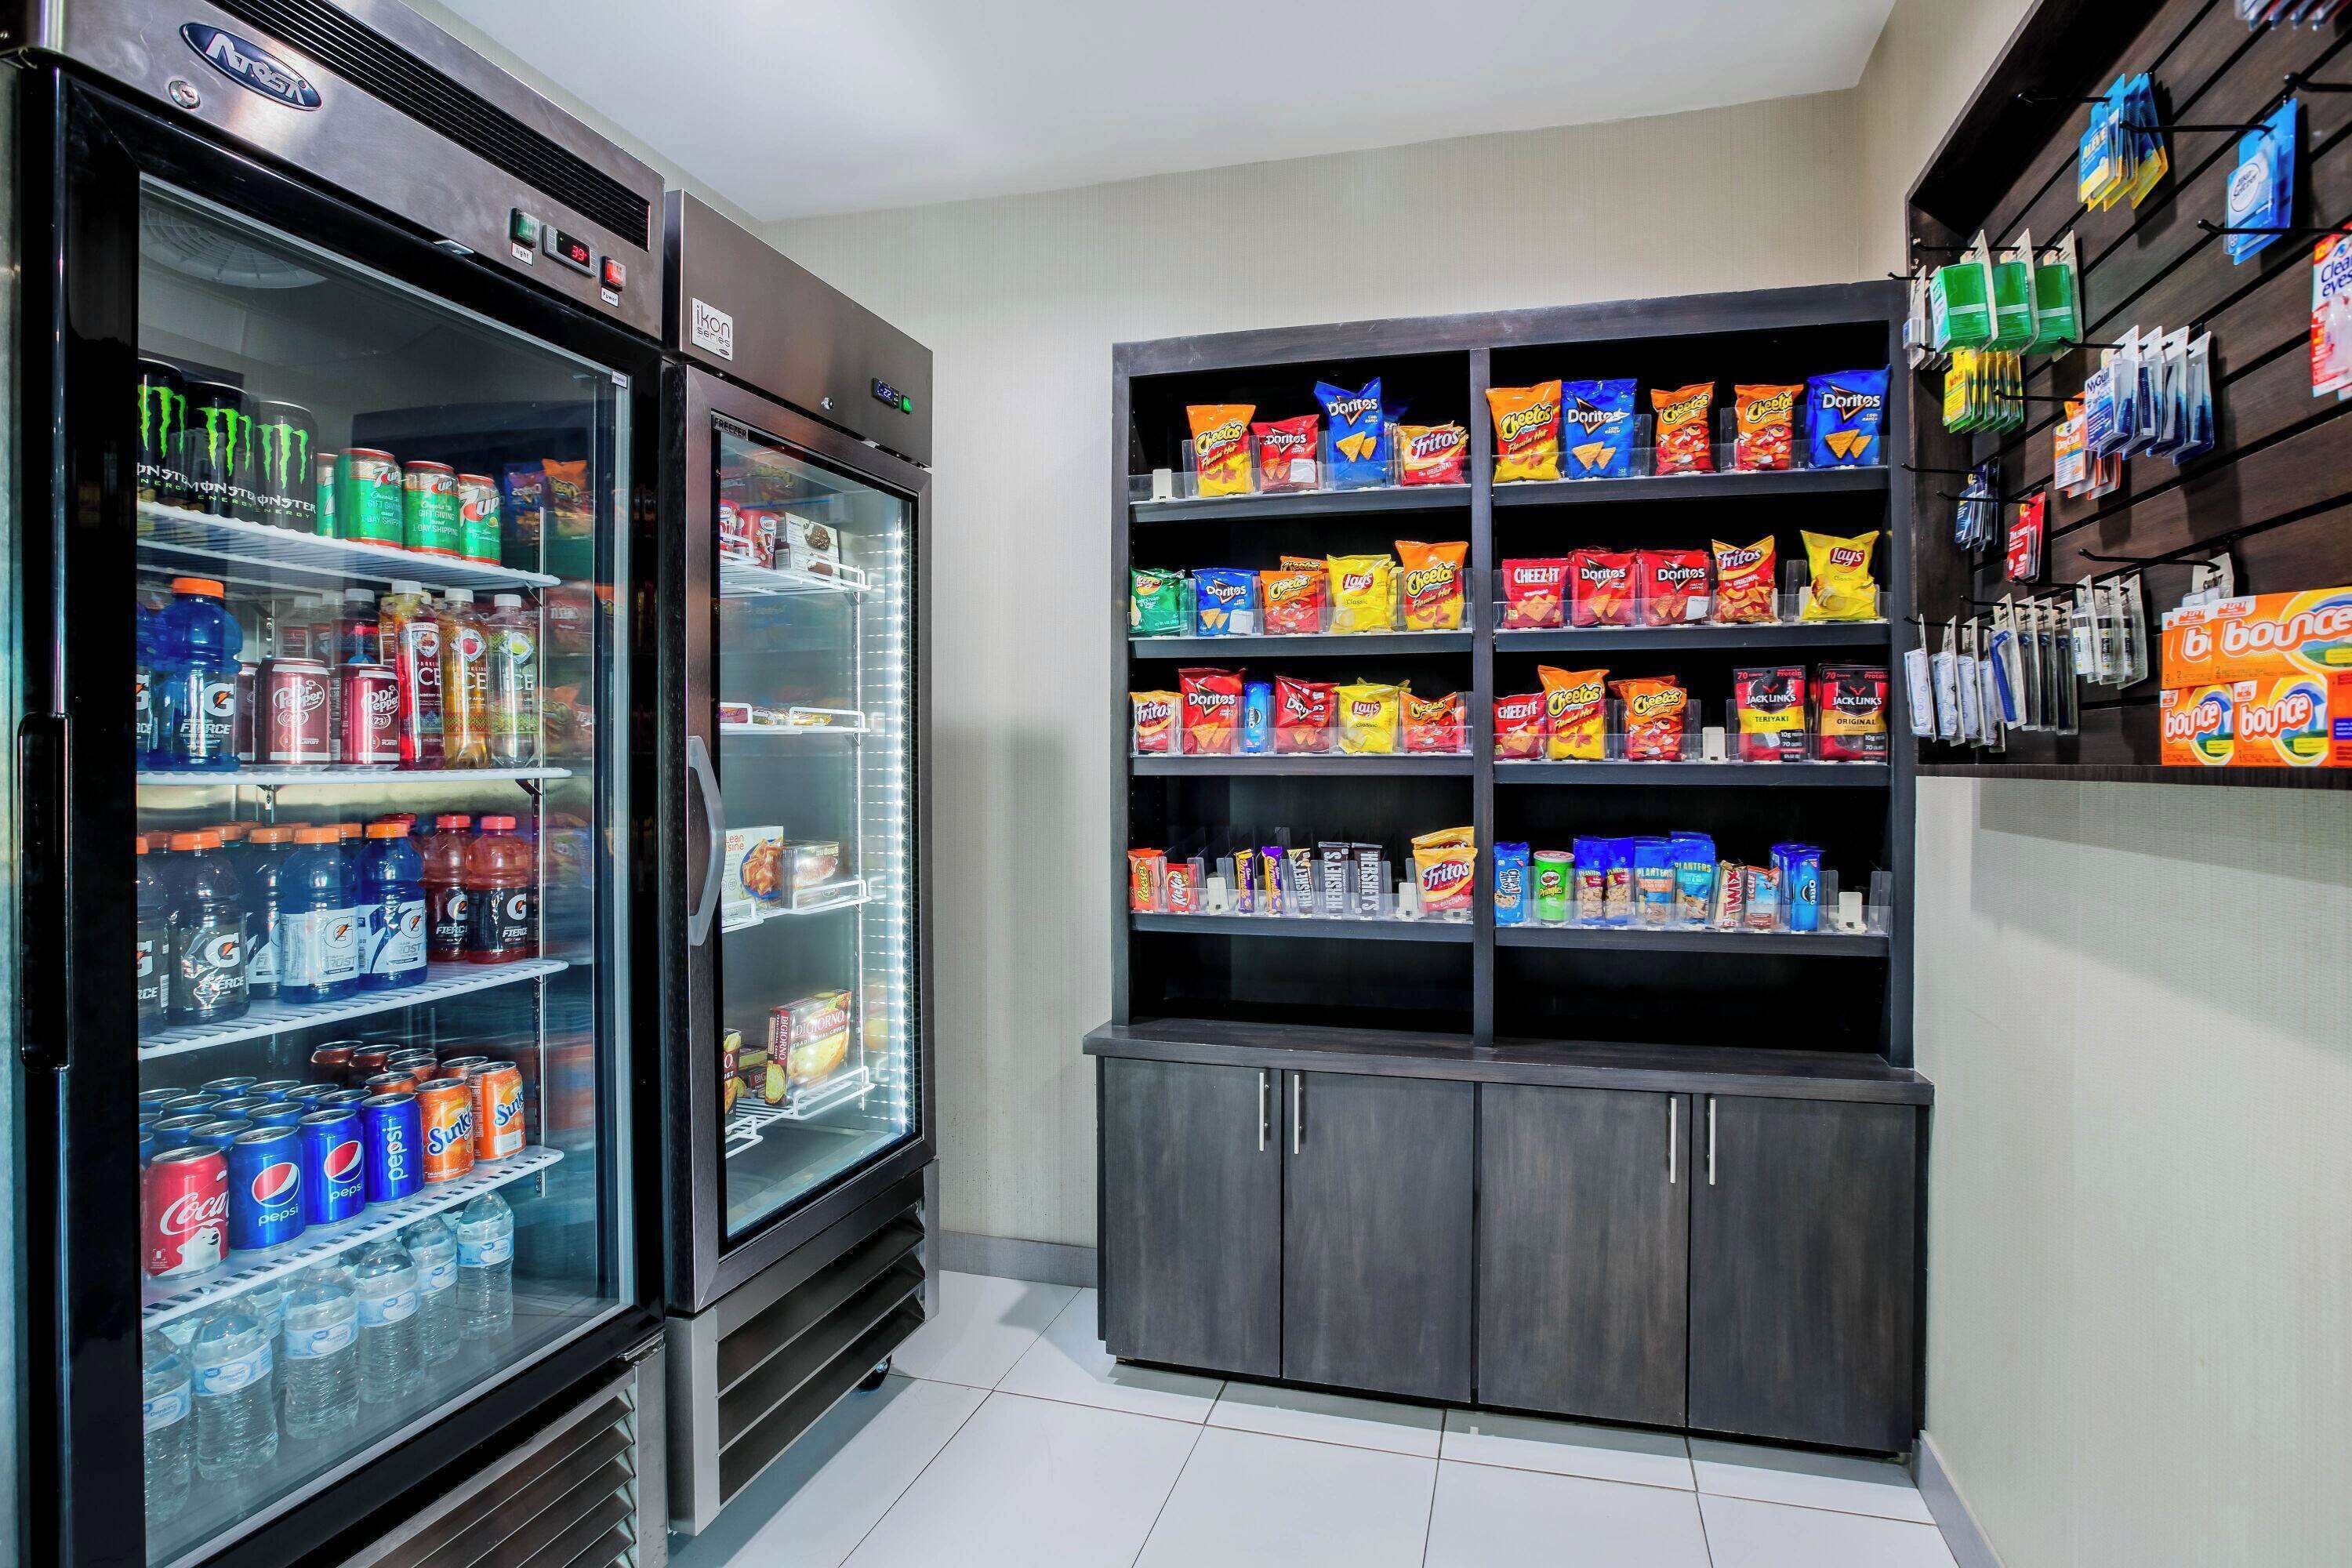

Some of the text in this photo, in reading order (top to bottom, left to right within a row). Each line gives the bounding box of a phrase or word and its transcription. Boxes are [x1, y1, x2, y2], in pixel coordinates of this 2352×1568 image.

[515, 246, 530, 260] light
[2321, 256, 2352, 283] Clea
[695, 303, 731, 338] ikon
[696, 326, 731, 347] series
[1327, 397, 1378, 416] Doritos
[1661, 392, 1710, 424] Cheetos
[1822, 393, 1881, 409] Doritos
[1500, 402, 1553, 442] Cheetos
[1568, 408, 1621, 423] Doritos
[713, 417, 747, 440] FREEZER
[1196, 423, 1243, 456] Cheetos
[1265, 433, 1306, 445] Doritos
[1410, 430, 1461, 459] Fritos
[136, 462, 188, 485] ONSTE
[140, 478, 187, 492] NERGY
[187, 480, 256, 502] MONSTE
[257, 494, 317, 514] ONSTER
[1715, 548, 1762, 571] Fritos
[1581, 568, 1626, 579] Doritos
[1657, 567, 1705, 580] Doritos
[1205, 585, 1247, 596] Doritos
[2223, 604, 2352, 654] bounce
[417, 666, 441, 686] CE
[466, 672, 488, 691] CE
[204, 682, 234, 717] G
[368, 691, 399, 713] Pepper
[379, 688, 394, 699] Dr
[1188, 692, 1236, 706] Doritos
[1547, 684, 1602, 717] Cheetos
[1633, 688, 1682, 716] Cheetos
[1746, 695, 1769, 705] JACK
[1832, 696, 1857, 706] JACK
[1136, 701, 1173, 722] Fritos
[1286, 695, 1325, 721] Doros
[2240, 695, 2312, 739] bounce
[180, 722, 233, 735] FRCE
[1837, 717, 1876, 726] ORIGINAL
[2164, 701, 2219, 740] bounce
[725, 842, 745, 852] sine
[1323, 851, 1344, 909] HERSHEY'S
[1360, 851, 1380, 911] HERSHEY'S
[1421, 861, 1470, 891] Fritos
[1538, 886, 1563, 898] Pringles
[1724, 870, 1742, 916] TWIX
[436, 925, 467, 935] FIERC
[502, 927, 528, 938] FIERCE
[204, 932, 241, 968] G
[779, 1016, 789, 1061] DIGIORNO
[494, 1091, 524, 1128] Sunk
[426, 1109, 474, 1156] Sunk
[382, 1123, 408, 1181] pepsi
[328, 1181, 363, 1203] pepsi
[257, 1203, 299, 1227] pepsi
